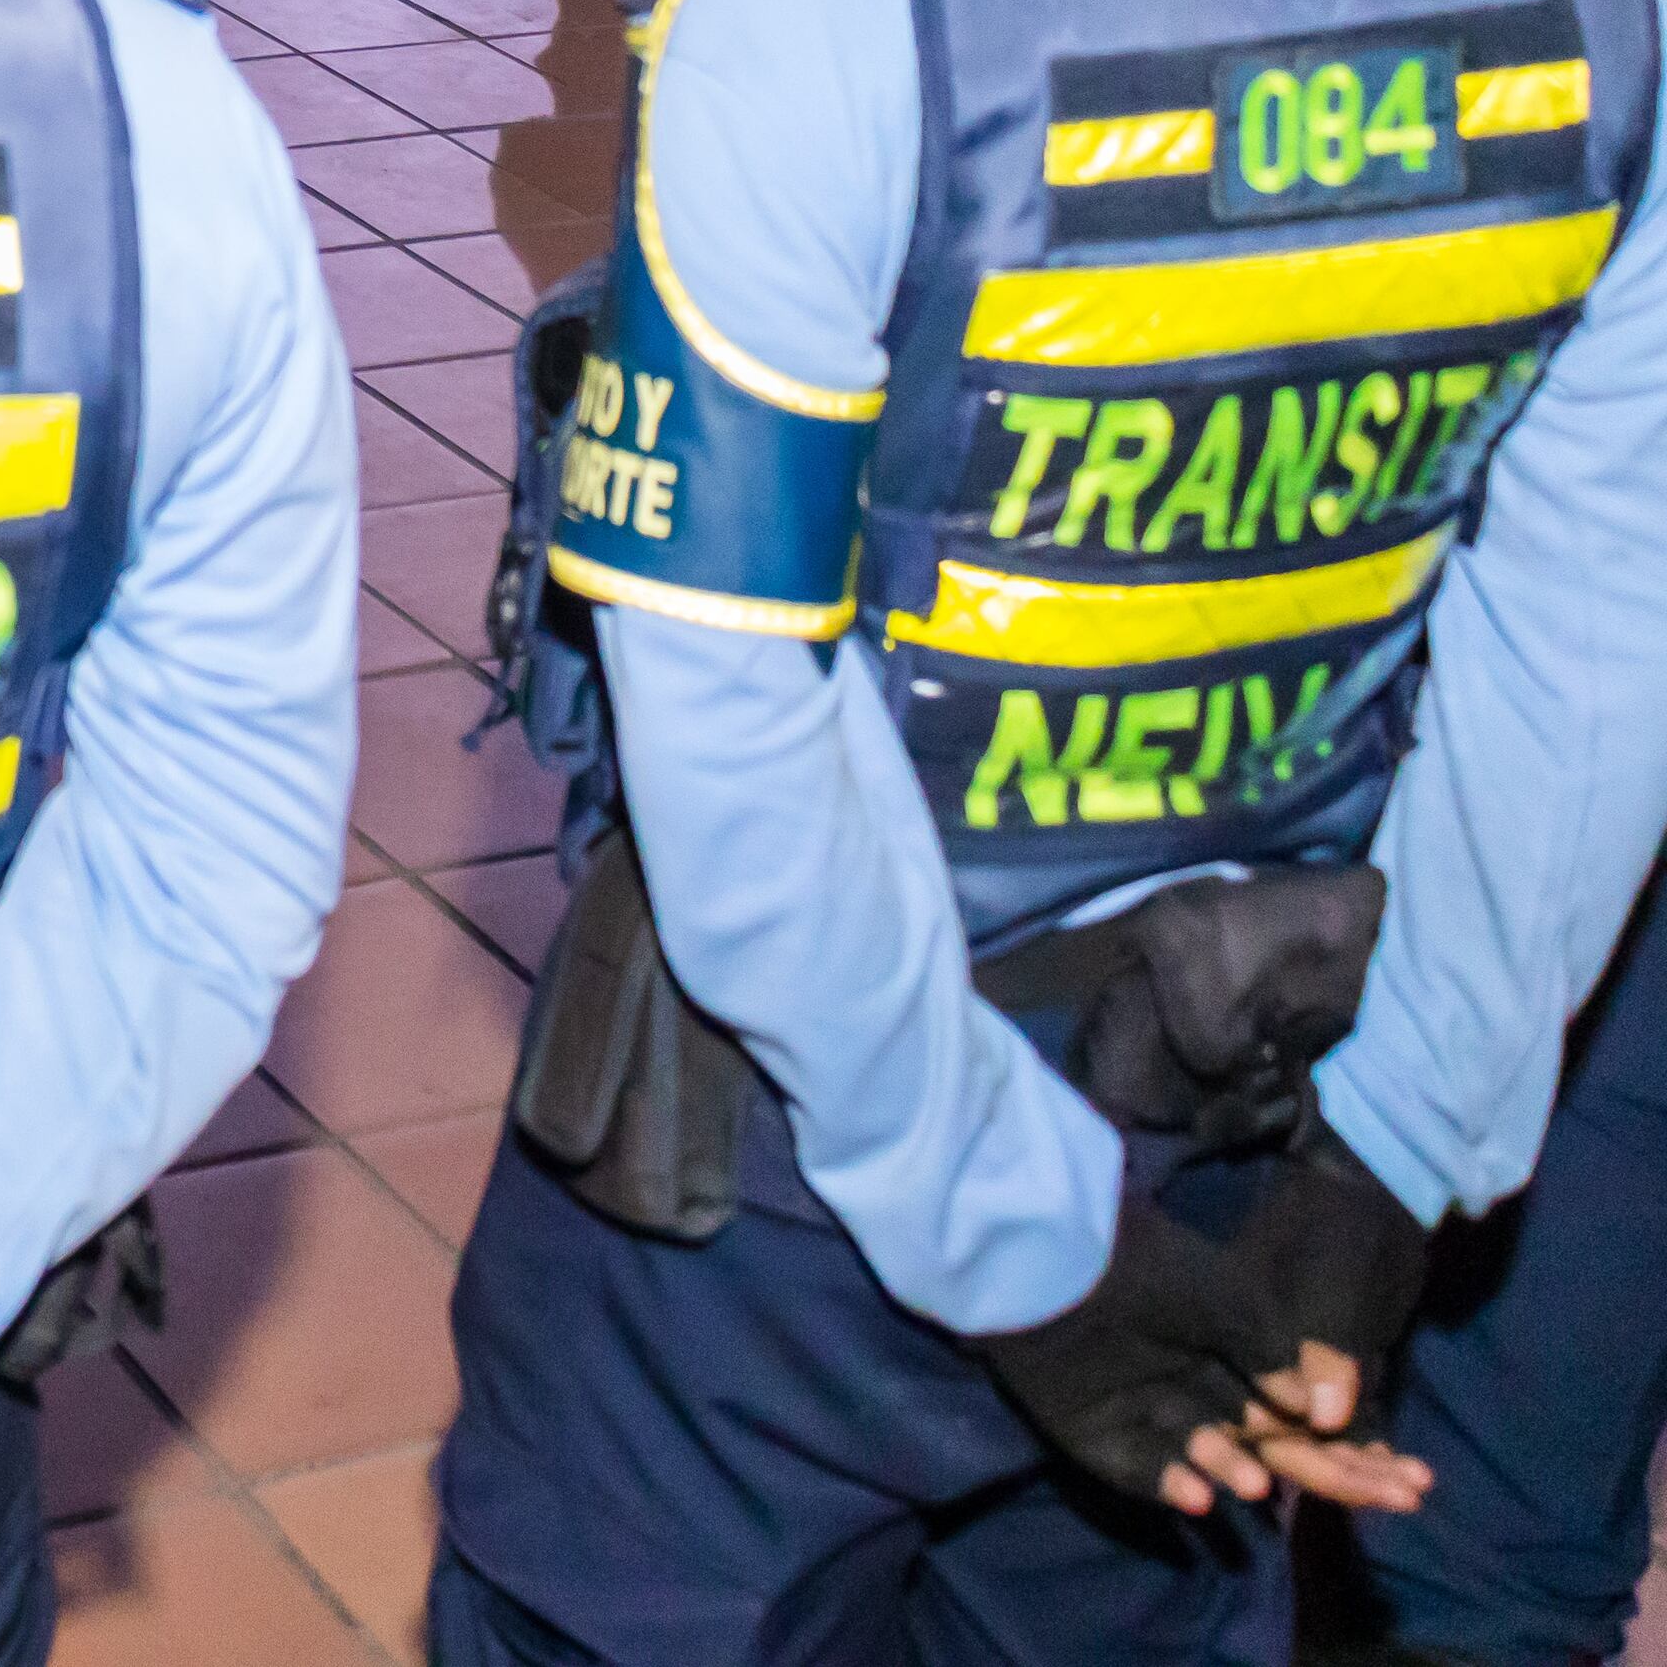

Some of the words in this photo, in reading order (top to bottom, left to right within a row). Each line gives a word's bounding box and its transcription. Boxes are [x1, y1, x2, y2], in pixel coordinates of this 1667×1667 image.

[1238, 58, 1437, 197] 084
[634, 371, 675, 452] Y
[989, 350, 1539, 553] TRANSIT
[964, 660, 1335, 830] NEIV
